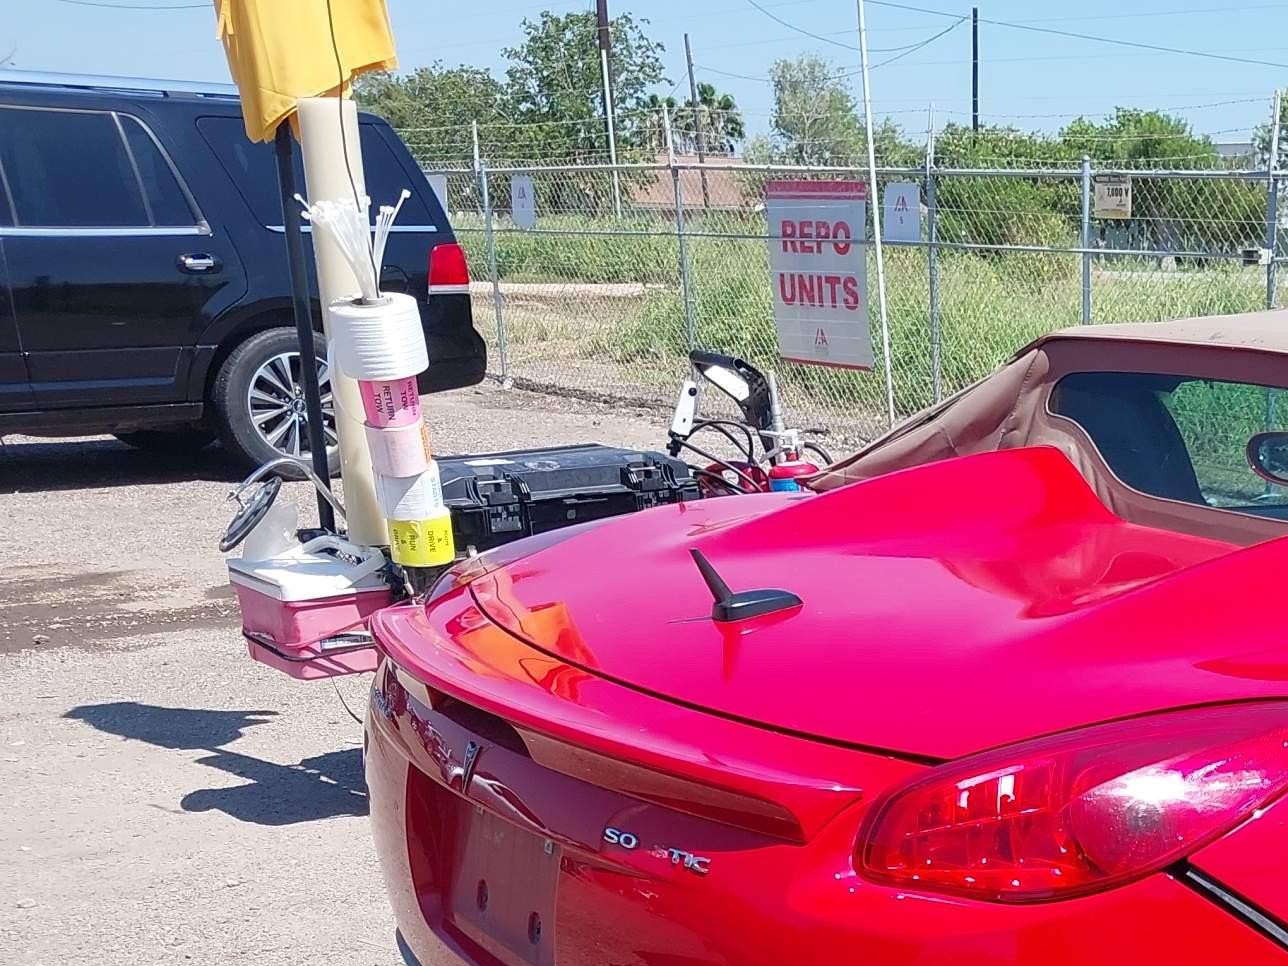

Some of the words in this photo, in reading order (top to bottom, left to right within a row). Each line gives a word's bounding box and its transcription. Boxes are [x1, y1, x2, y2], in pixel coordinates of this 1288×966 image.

[781, 220, 851, 255] REPO
[779, 272, 860, 310] UNITS
[374, 393, 385, 414] TOW
[382, 385, 396, 421] RETURN
[408, 534, 417, 551] RUN
